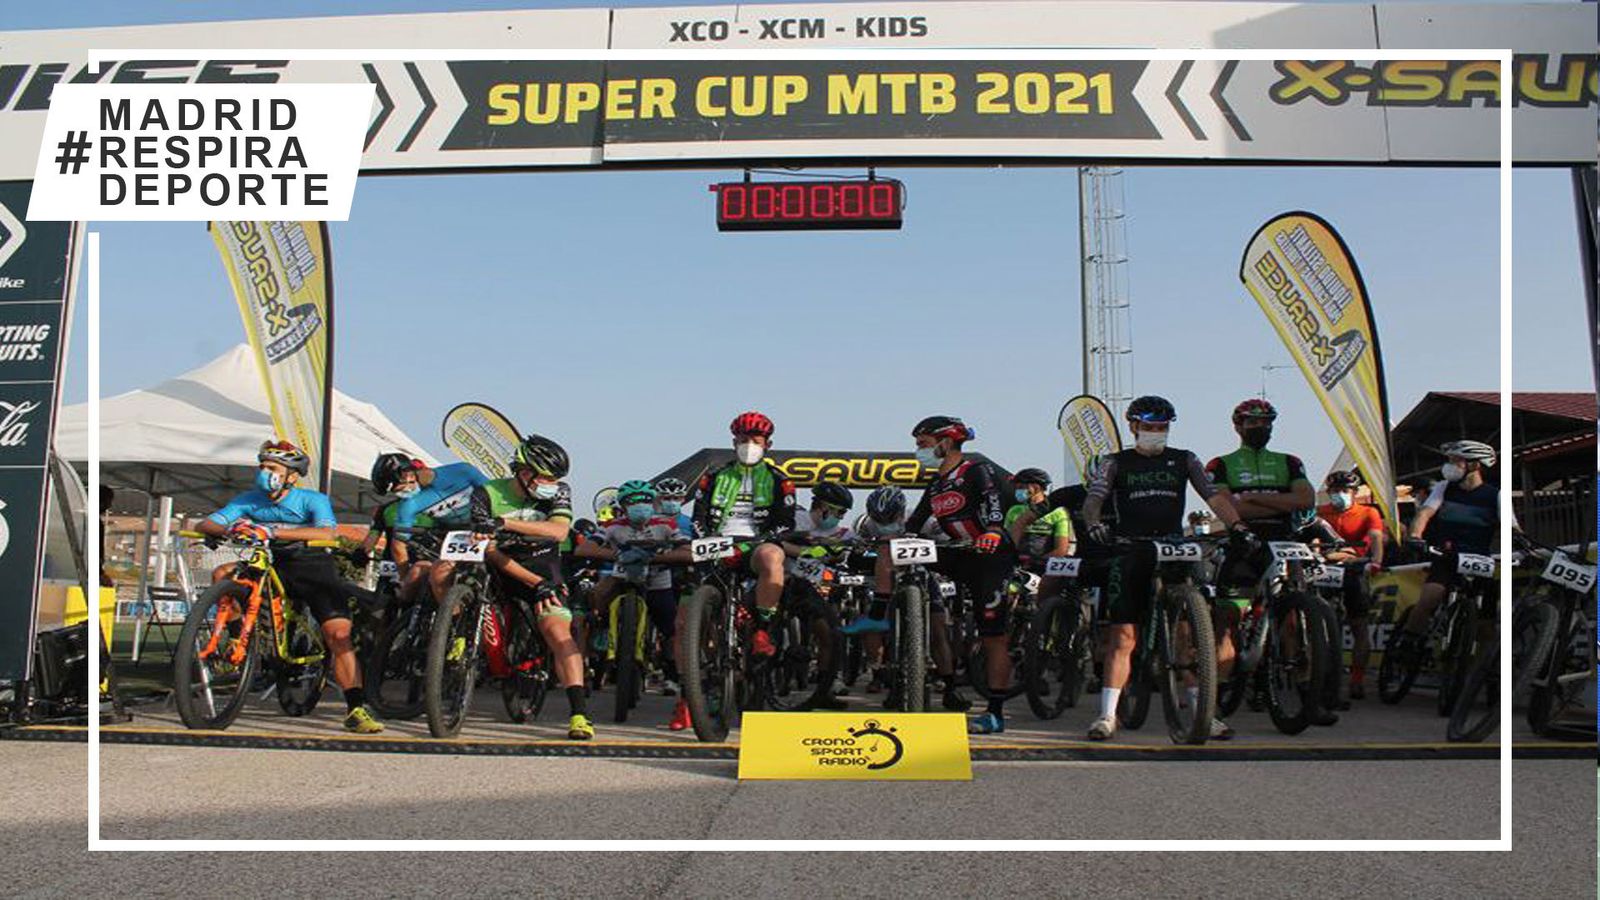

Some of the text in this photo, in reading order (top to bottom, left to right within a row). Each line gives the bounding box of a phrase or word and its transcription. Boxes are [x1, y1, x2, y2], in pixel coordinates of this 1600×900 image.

[669, 20, 730, 42] XCO
[759, 18, 825, 40] XCM
[856, 17, 928, 38] KIDS
[487, 72, 1113, 126] SUPER CUP MTB 2021
[722, 184, 893, 219] 00:00:00
[446, 543, 480, 555] 554
[696, 541, 730, 556] 025
[897, 547, 931, 560] 273
[1161, 546, 1197, 557] 053
[1050, 561, 1075, 571] 274
[1461, 560, 1490, 573] 463
[1550, 564, 1590, 588] 095
[802, 737, 856, 746] CRONO
[810, 747, 864, 756] SPORT
[818, 757, 868, 766] RADIO
